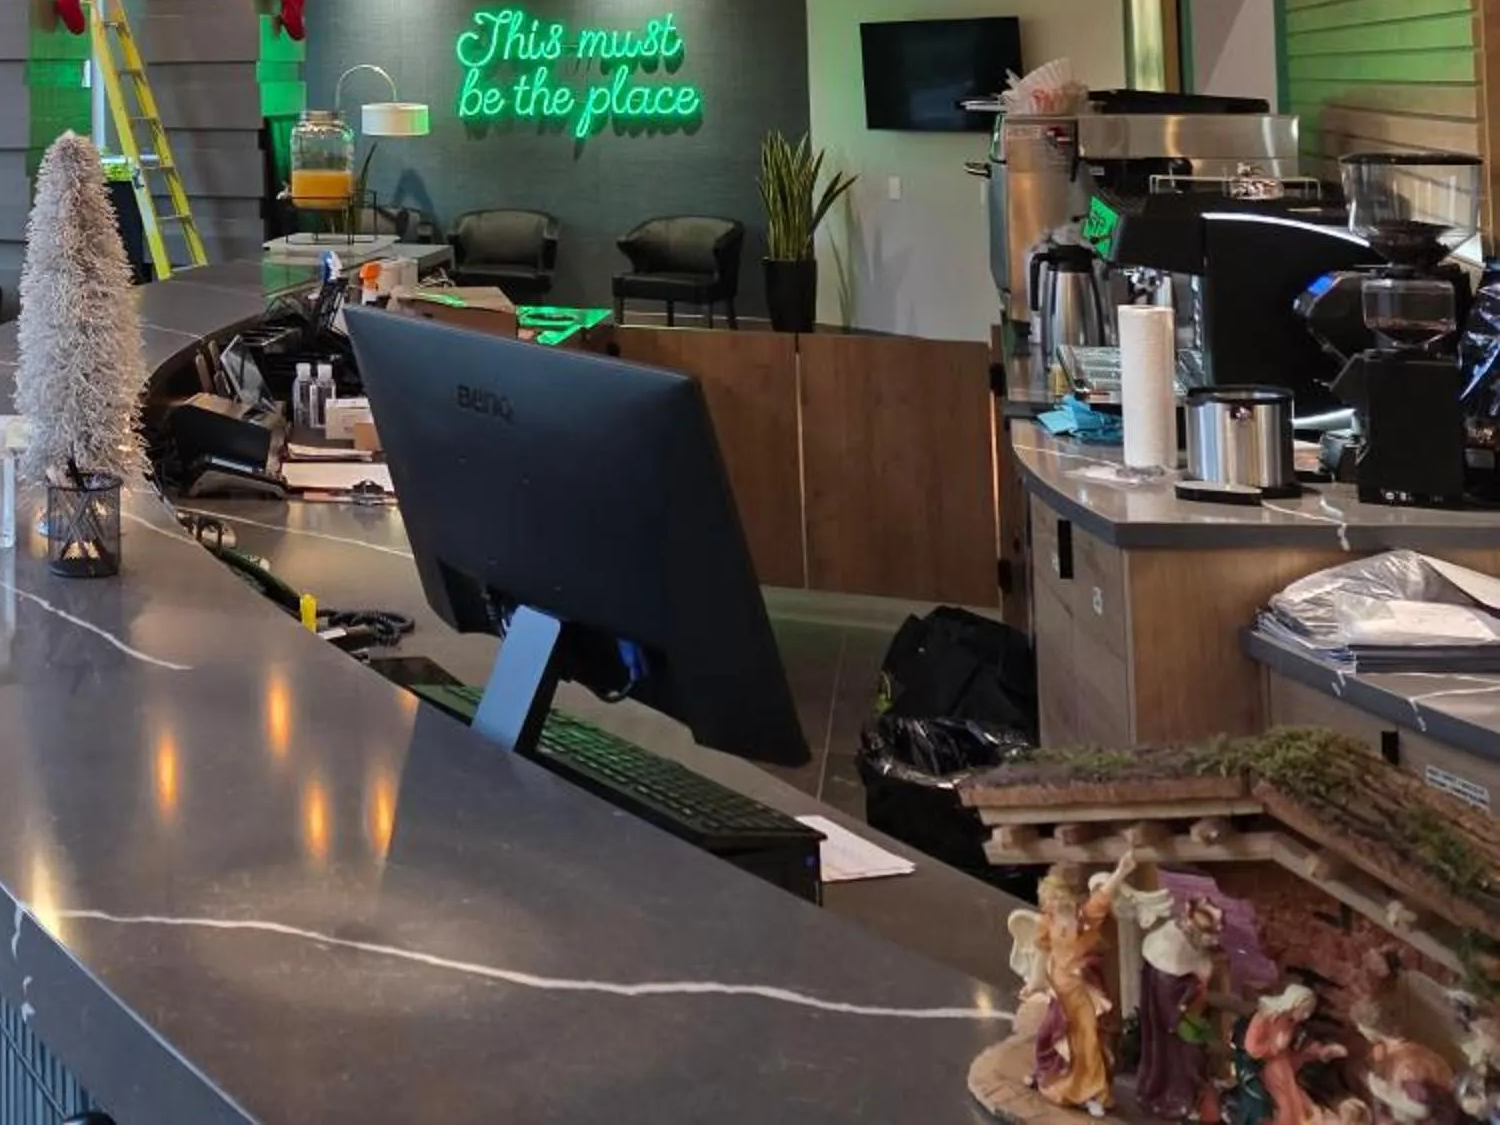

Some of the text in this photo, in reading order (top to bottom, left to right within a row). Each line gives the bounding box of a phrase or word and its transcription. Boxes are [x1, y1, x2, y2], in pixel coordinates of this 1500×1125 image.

[457, 10, 682, 67] This must
[459, 65, 699, 138] be the place
